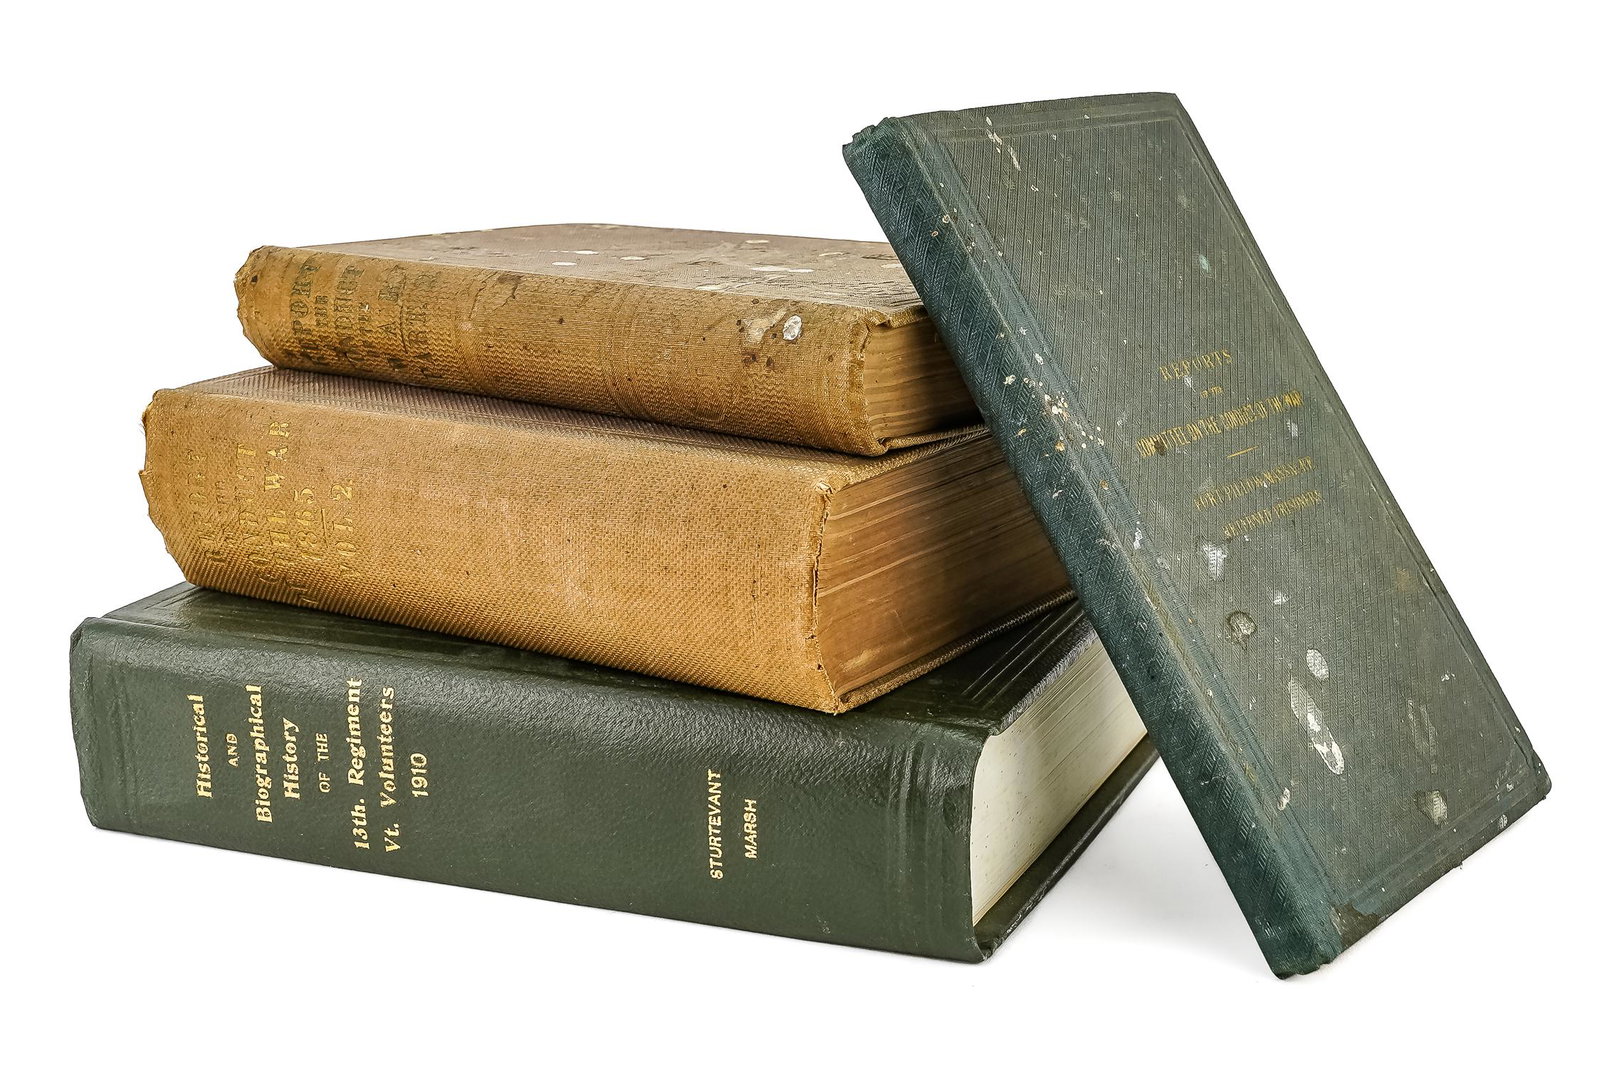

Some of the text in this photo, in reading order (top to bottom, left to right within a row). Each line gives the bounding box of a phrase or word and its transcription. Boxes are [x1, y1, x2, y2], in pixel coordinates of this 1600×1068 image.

[1159, 348, 1233, 382] REPORTS
[264, 421, 289, 491] WAR
[1186, 423, 1203, 441] ON
[1198, 416, 1222, 436] THE
[293, 488, 322, 561] 1865
[187, 694, 214, 799] Historical
[226, 733, 239, 767] AND
[245, 684, 273, 823] Biographical
[282, 717, 301, 800] History
[315, 732, 331, 793] OF THE
[346, 678, 370, 850] 13th. Regiment
[377, 686, 401, 853] Vt. Volunteers
[410, 753, 429, 798] 1910
[707, 768, 724, 880] STURTEVANT
[743, 798, 758, 859] MARSH
